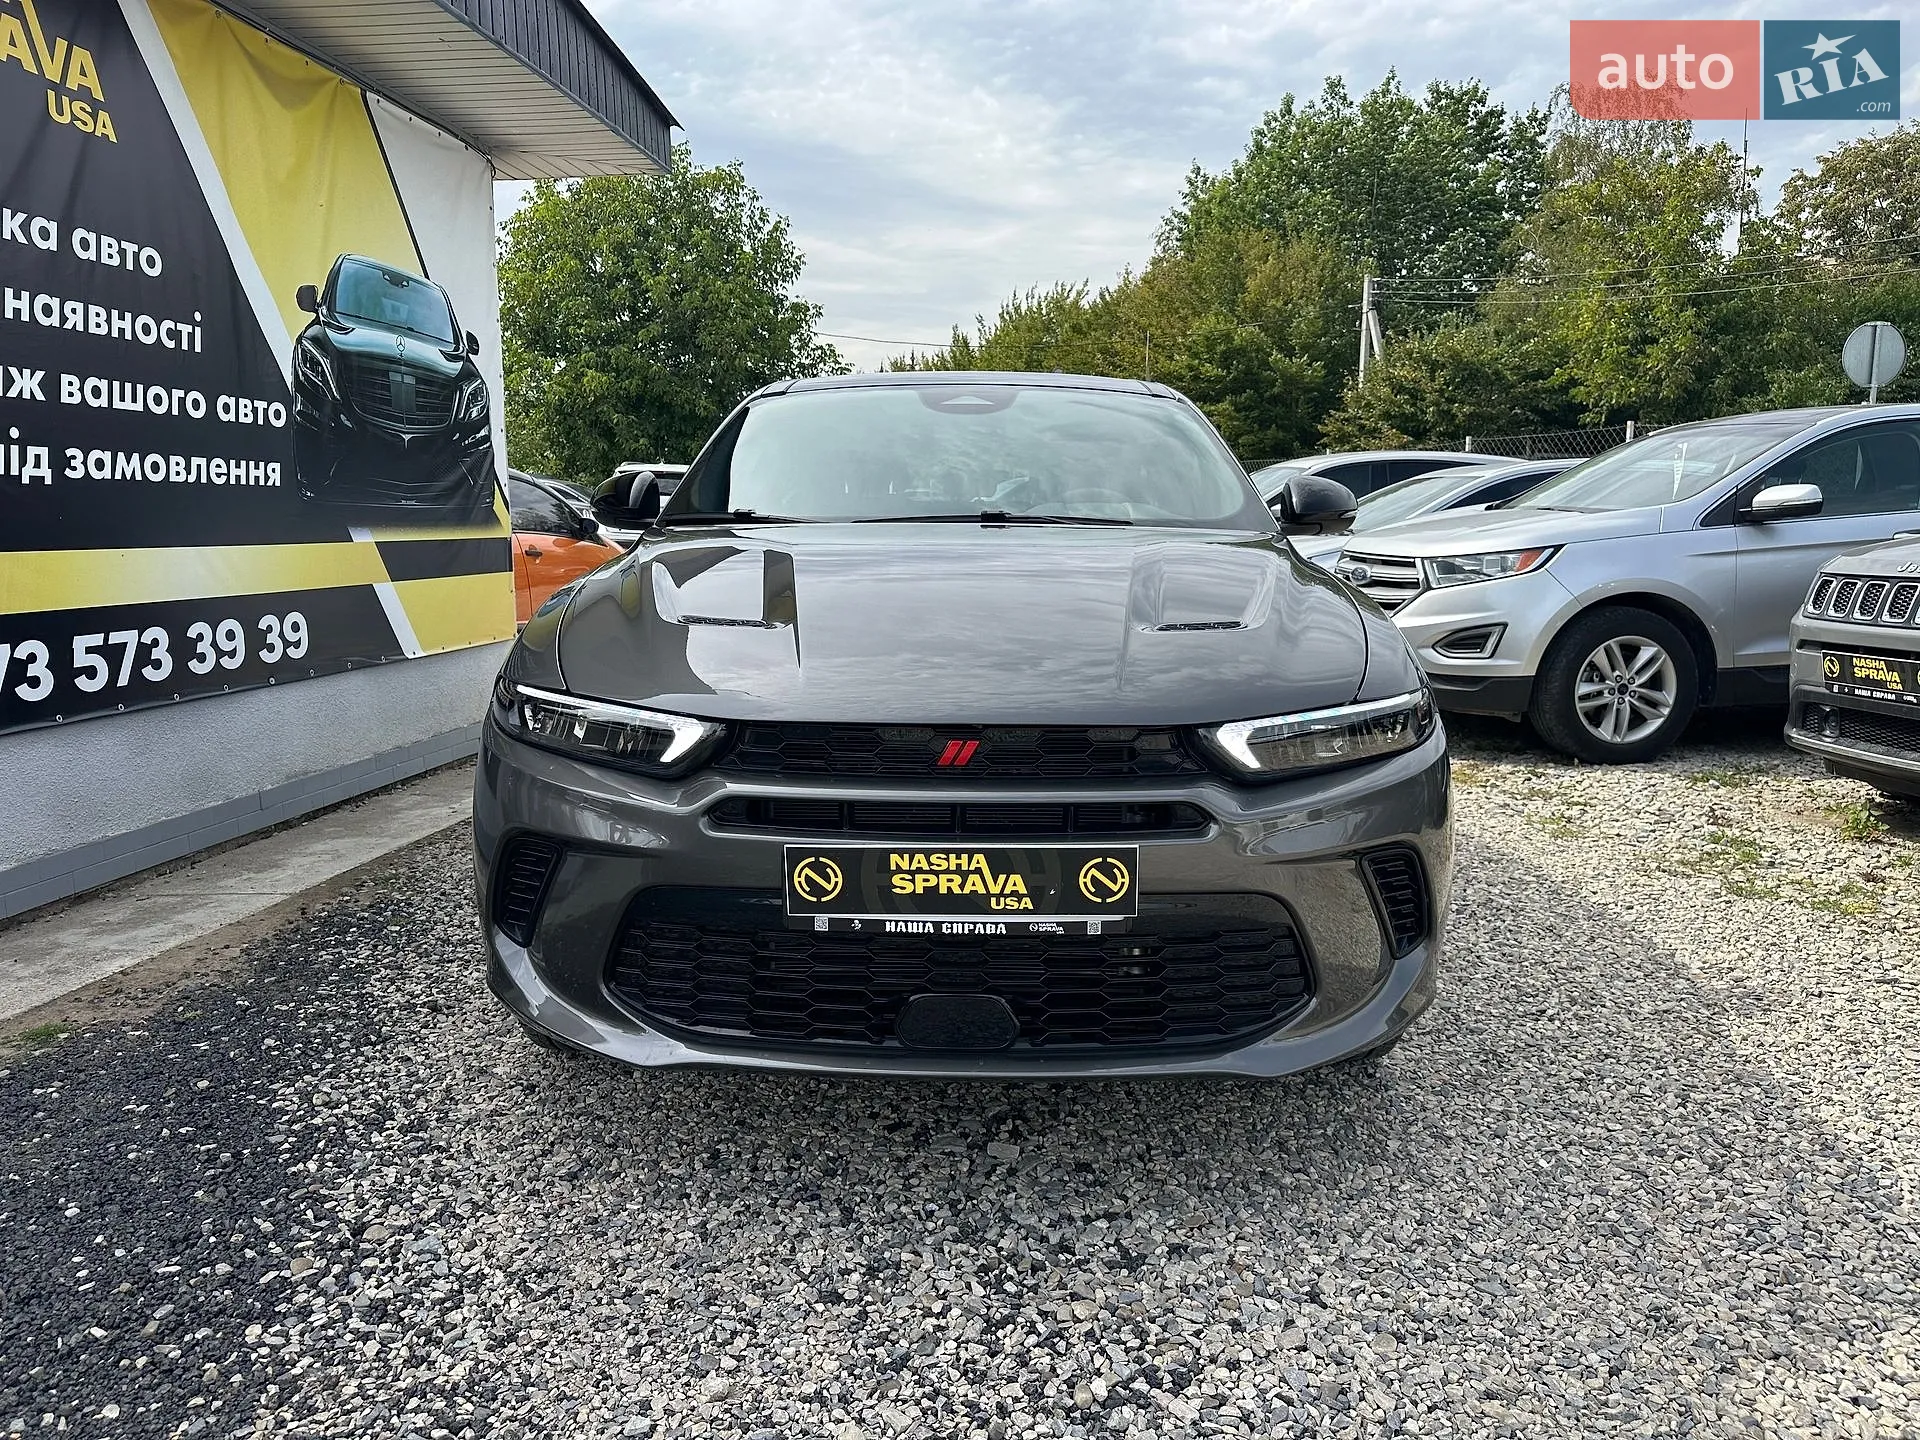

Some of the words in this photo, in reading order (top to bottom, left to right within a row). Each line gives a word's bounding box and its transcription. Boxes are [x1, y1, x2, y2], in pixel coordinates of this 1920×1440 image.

[47, 88, 117, 143] USA
[2, 207, 58, 252] ка
[71, 227, 163, 277] авто
[4, 287, 202, 353] наявності
[0, 365, 47, 402] ж
[60, 373, 207, 419] вашого
[216, 394, 287, 428] авто
[0, 426, 52, 485] ід
[63, 447, 281, 487] замовлення
[72, 626, 173, 692] 573
[186, 618, 245, 675] 39
[257, 611, 309, 664] 39
[1852, 657, 1887, 669] NASHA
[1853, 667, 1901, 683] SPRAVA
[1886, 681, 1904, 690] USA
[889, 853, 987, 871] NASHA
[891, 873, 1028, 894] SPRAVA
[990, 897, 1034, 910] USA
[885, 921, 934, 934] НАША
[942, 922, 1007, 935] СПРАВА
